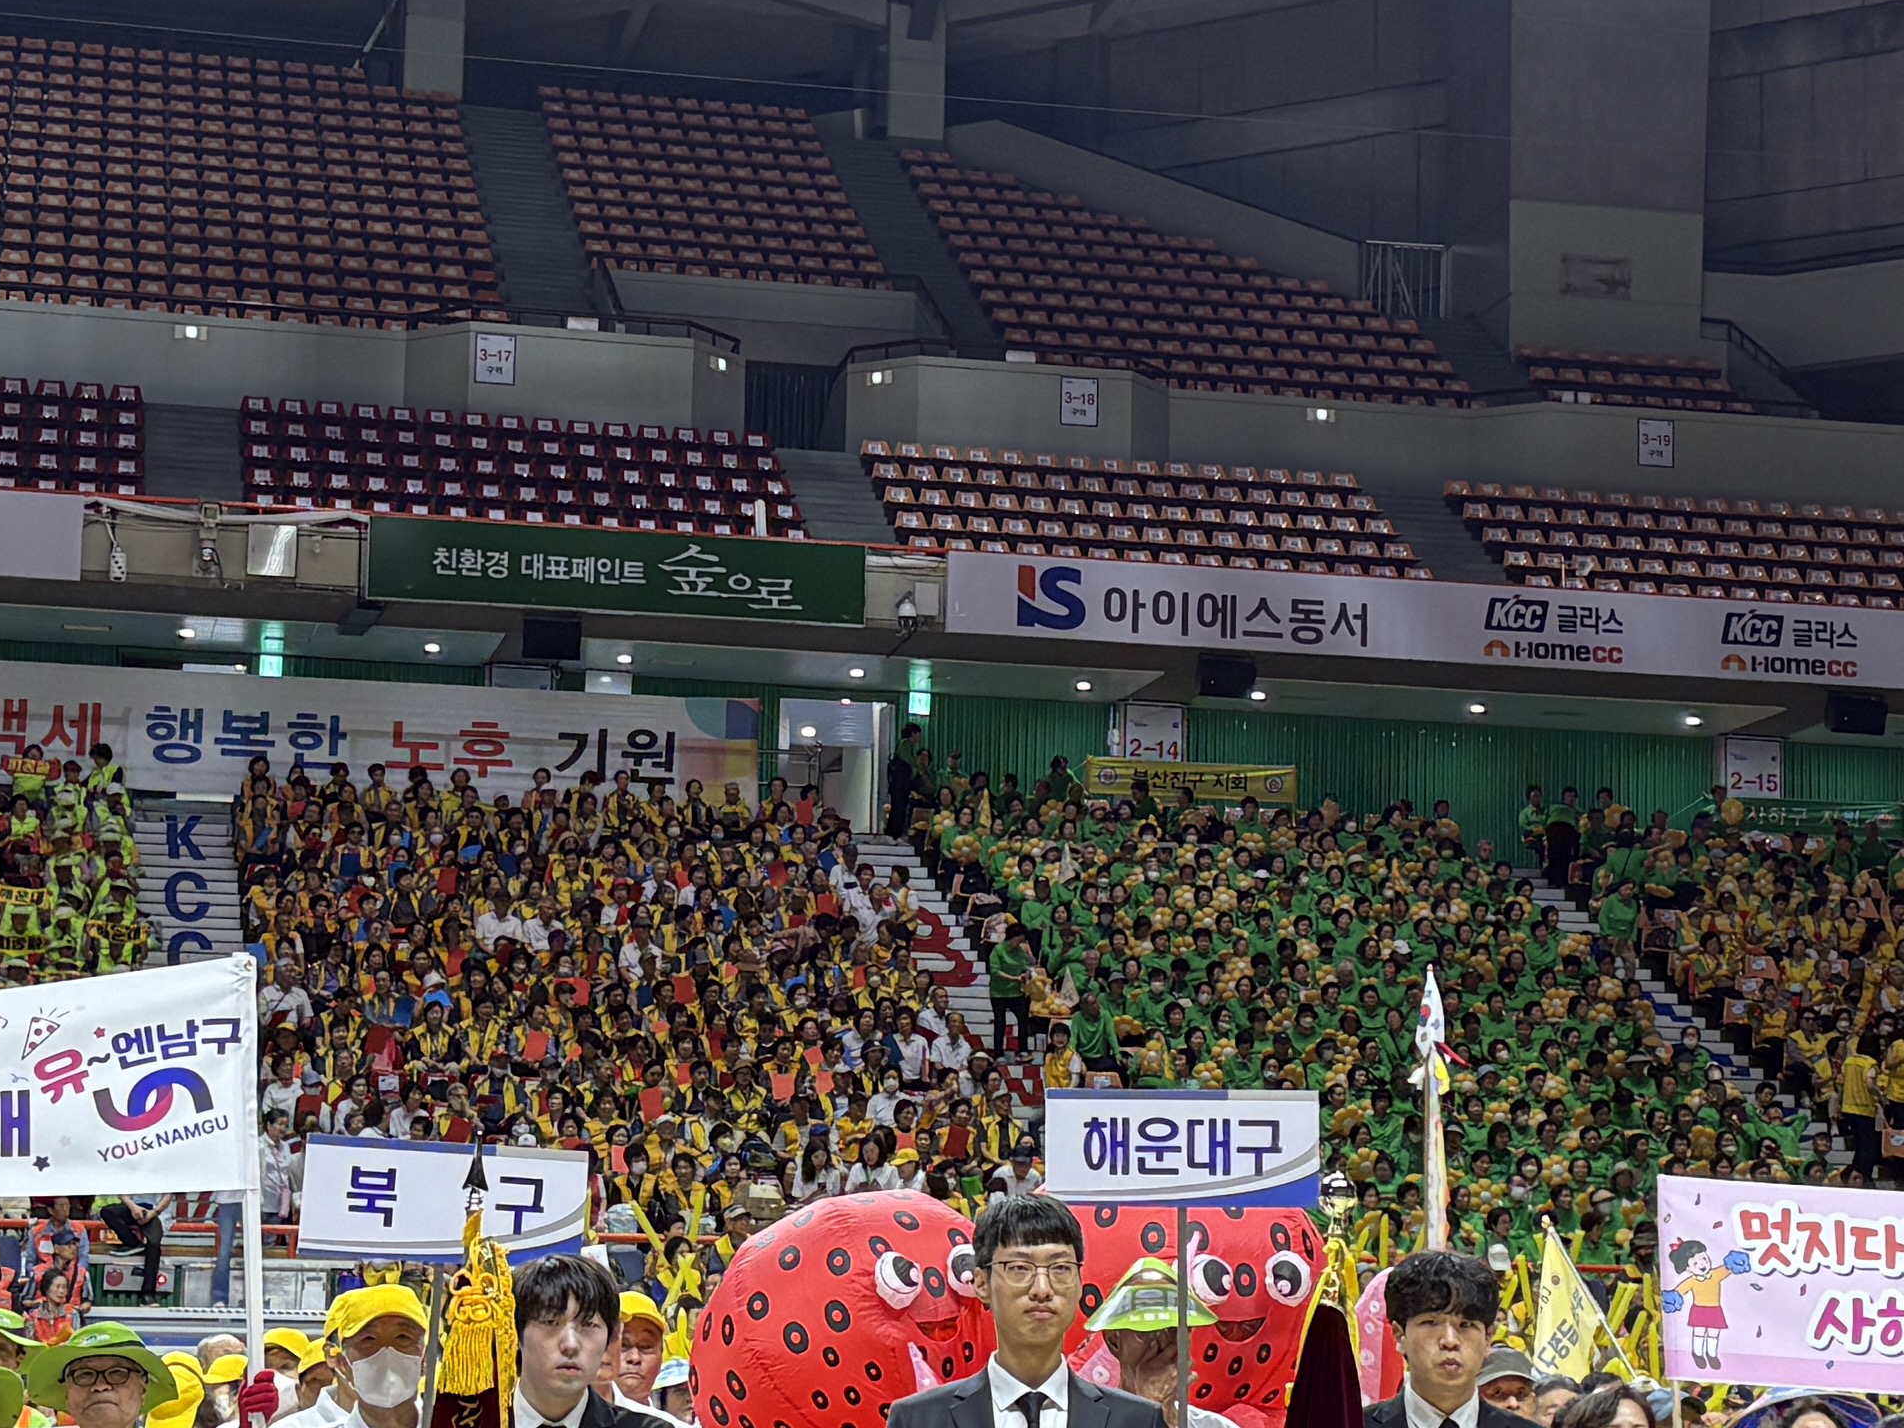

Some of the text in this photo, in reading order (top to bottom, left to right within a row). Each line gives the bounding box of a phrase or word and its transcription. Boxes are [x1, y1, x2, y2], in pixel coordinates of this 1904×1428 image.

[480, 348, 511, 362] 3-17
[1064, 391, 1095, 405] 3-18
[432, 545, 803, 611] 친환경 대표페인트 숲으로
[1102, 586, 1369, 647] 아이에스동서
[1490, 596, 1546, 632] KCC
[1556, 604, 1624, 636] 글라스
[1726, 610, 1782, 647] KCC
[1792, 619, 1858, 650] 글라스
[145, 704, 349, 775] 행복한
[385, 720, 513, 778] 노후
[553, 726, 676, 788] 기원
[1129, 738, 1180, 760] 2-14
[1730, 772, 1778, 792] 2-15
[97, 1115, 229, 1163] YOU&NAMGU
[1083, 1116, 1283, 1176] 해운대구
